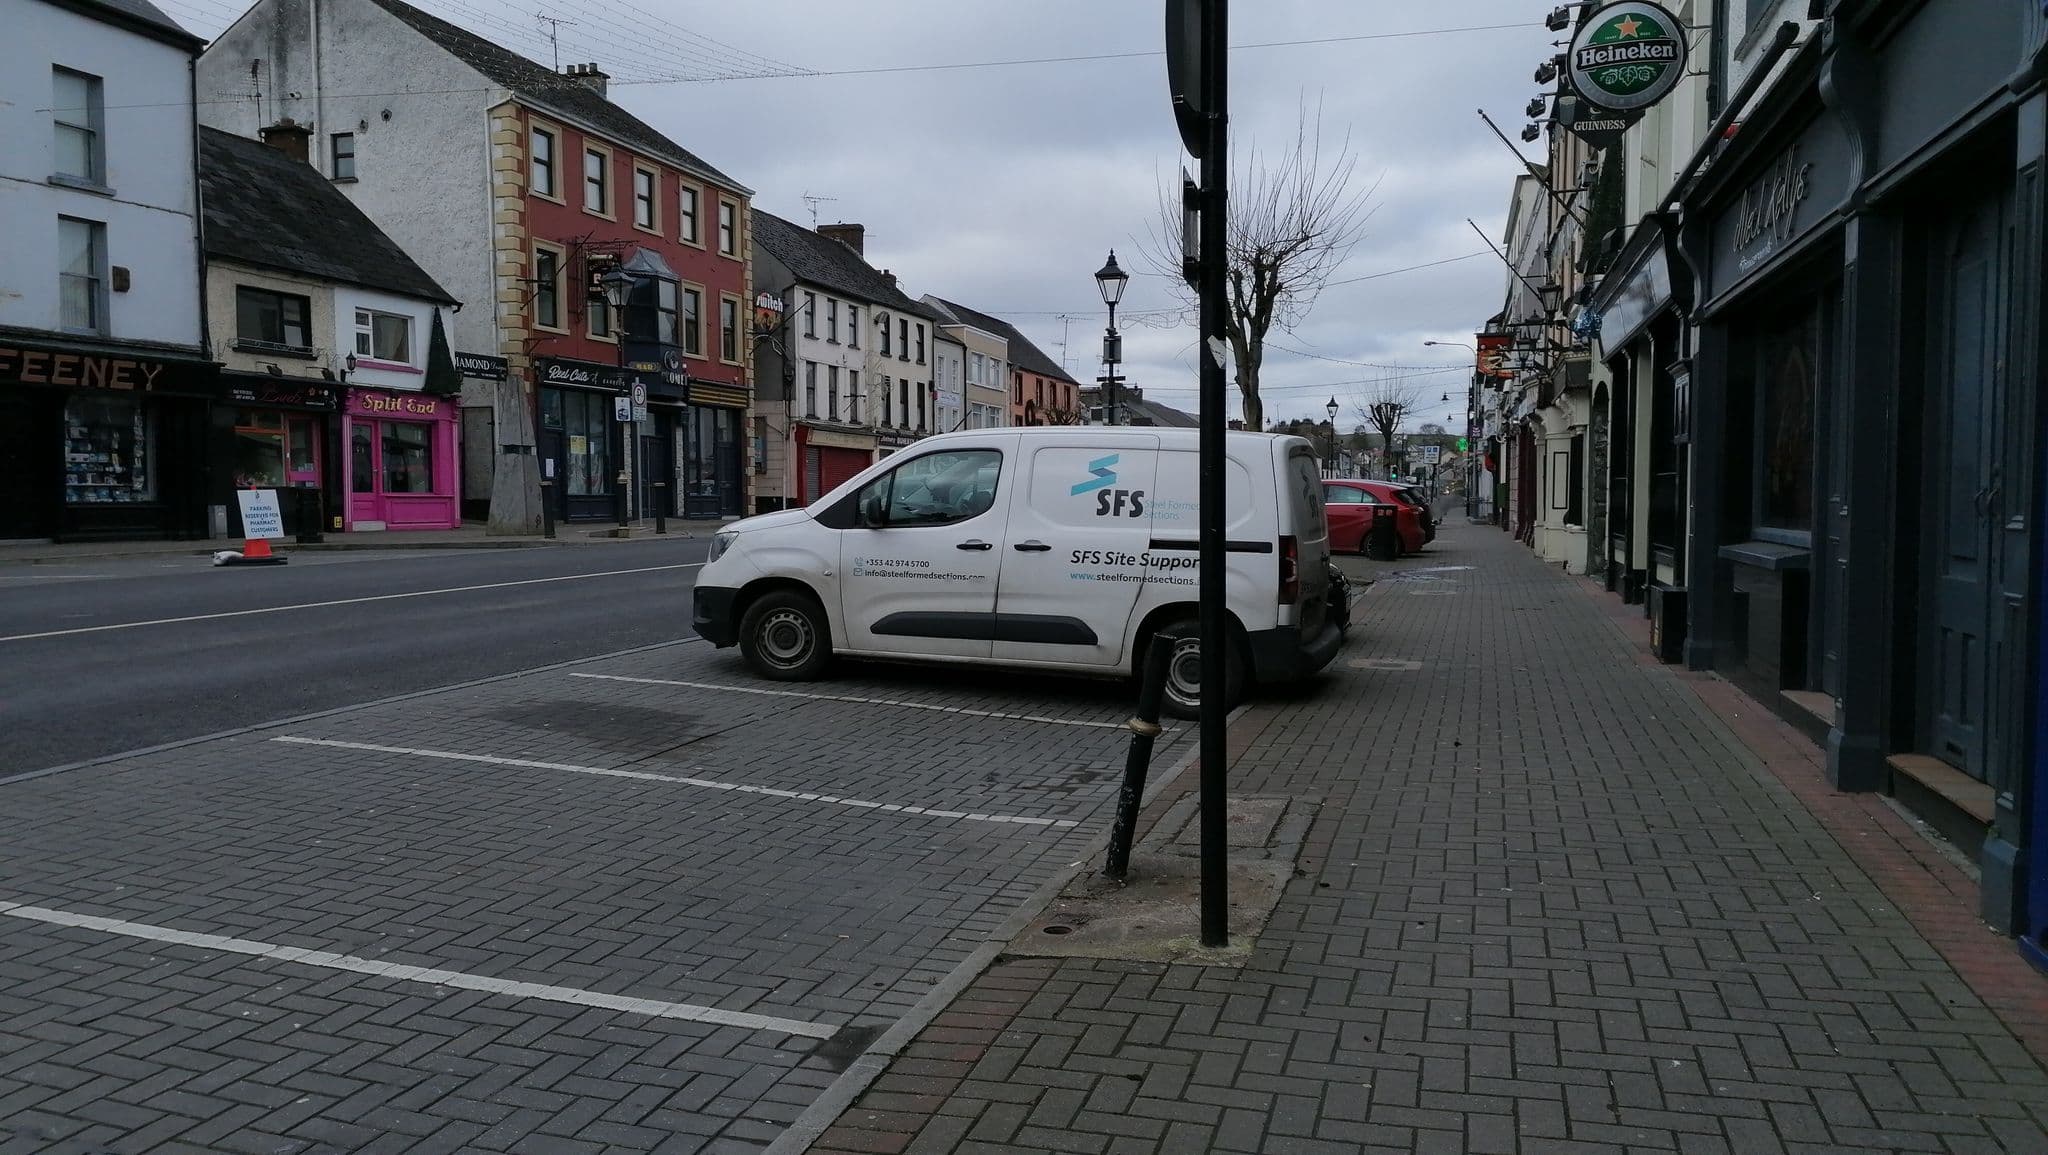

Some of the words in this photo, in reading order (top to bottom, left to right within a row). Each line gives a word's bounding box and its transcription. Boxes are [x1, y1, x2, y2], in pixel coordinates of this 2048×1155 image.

[1581, 42, 1675, 67] Heineken
[1573, 119, 1626, 131] GUINNESS
[455, 356, 490, 371] IAMOND
[362, 394, 402, 412] Split
[406, 398, 436, 414] End
[1096, 488, 1145, 518] SFS
[866, 559, 883, 567] +353
[884, 559, 895, 567] 42
[895, 559, 910, 568] 974
[910, 560, 930, 568] 5700
[1070, 550, 1101, 564] SFS
[1104, 551, 1136, 566] Site
[1139, 552, 1200, 571] Suppor
[1070, 572, 1200, 585] www.steelformedsections.
